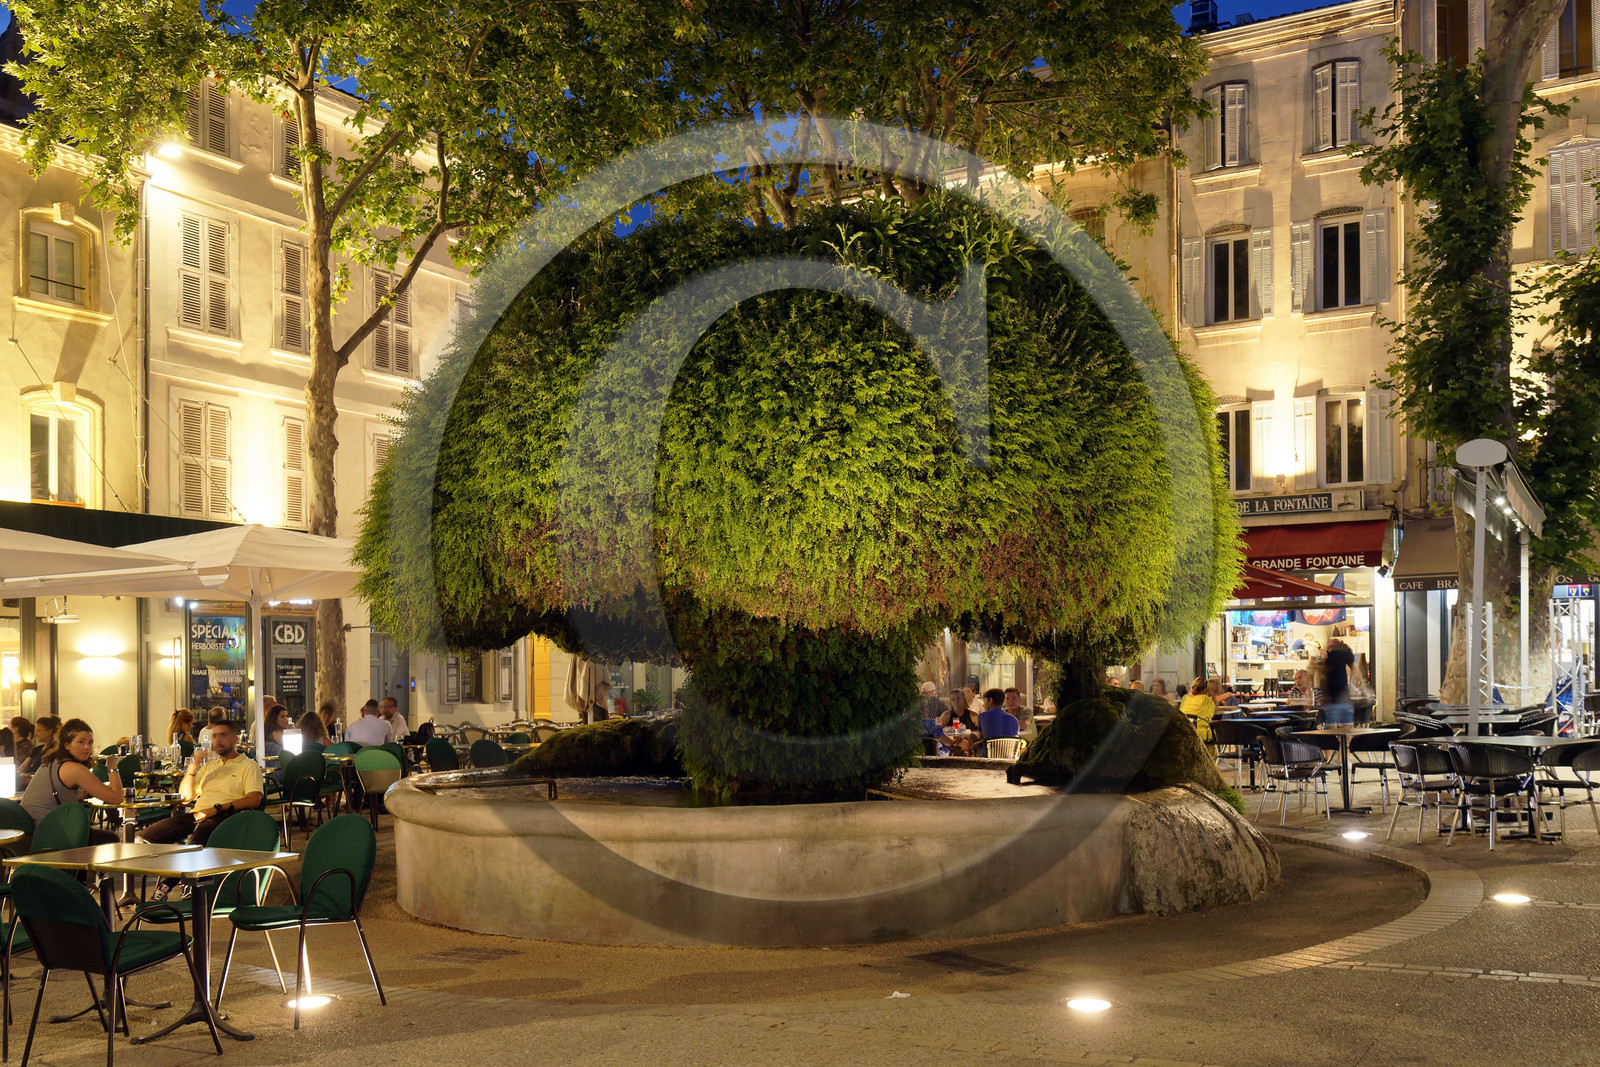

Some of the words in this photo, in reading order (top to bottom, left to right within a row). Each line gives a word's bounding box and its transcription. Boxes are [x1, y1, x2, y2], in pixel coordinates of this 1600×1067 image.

[1255, 500, 1269, 512] LA
[1274, 496, 1329, 511] FONTAINE
[1252, 558, 1301, 569] GRANDE
[1306, 554, 1365, 567] FONTAINE
[1400, 581, 1424, 590] CAFE
[275, 624, 305, 643] CBD
[191, 642, 226, 650] HERBORISTE
